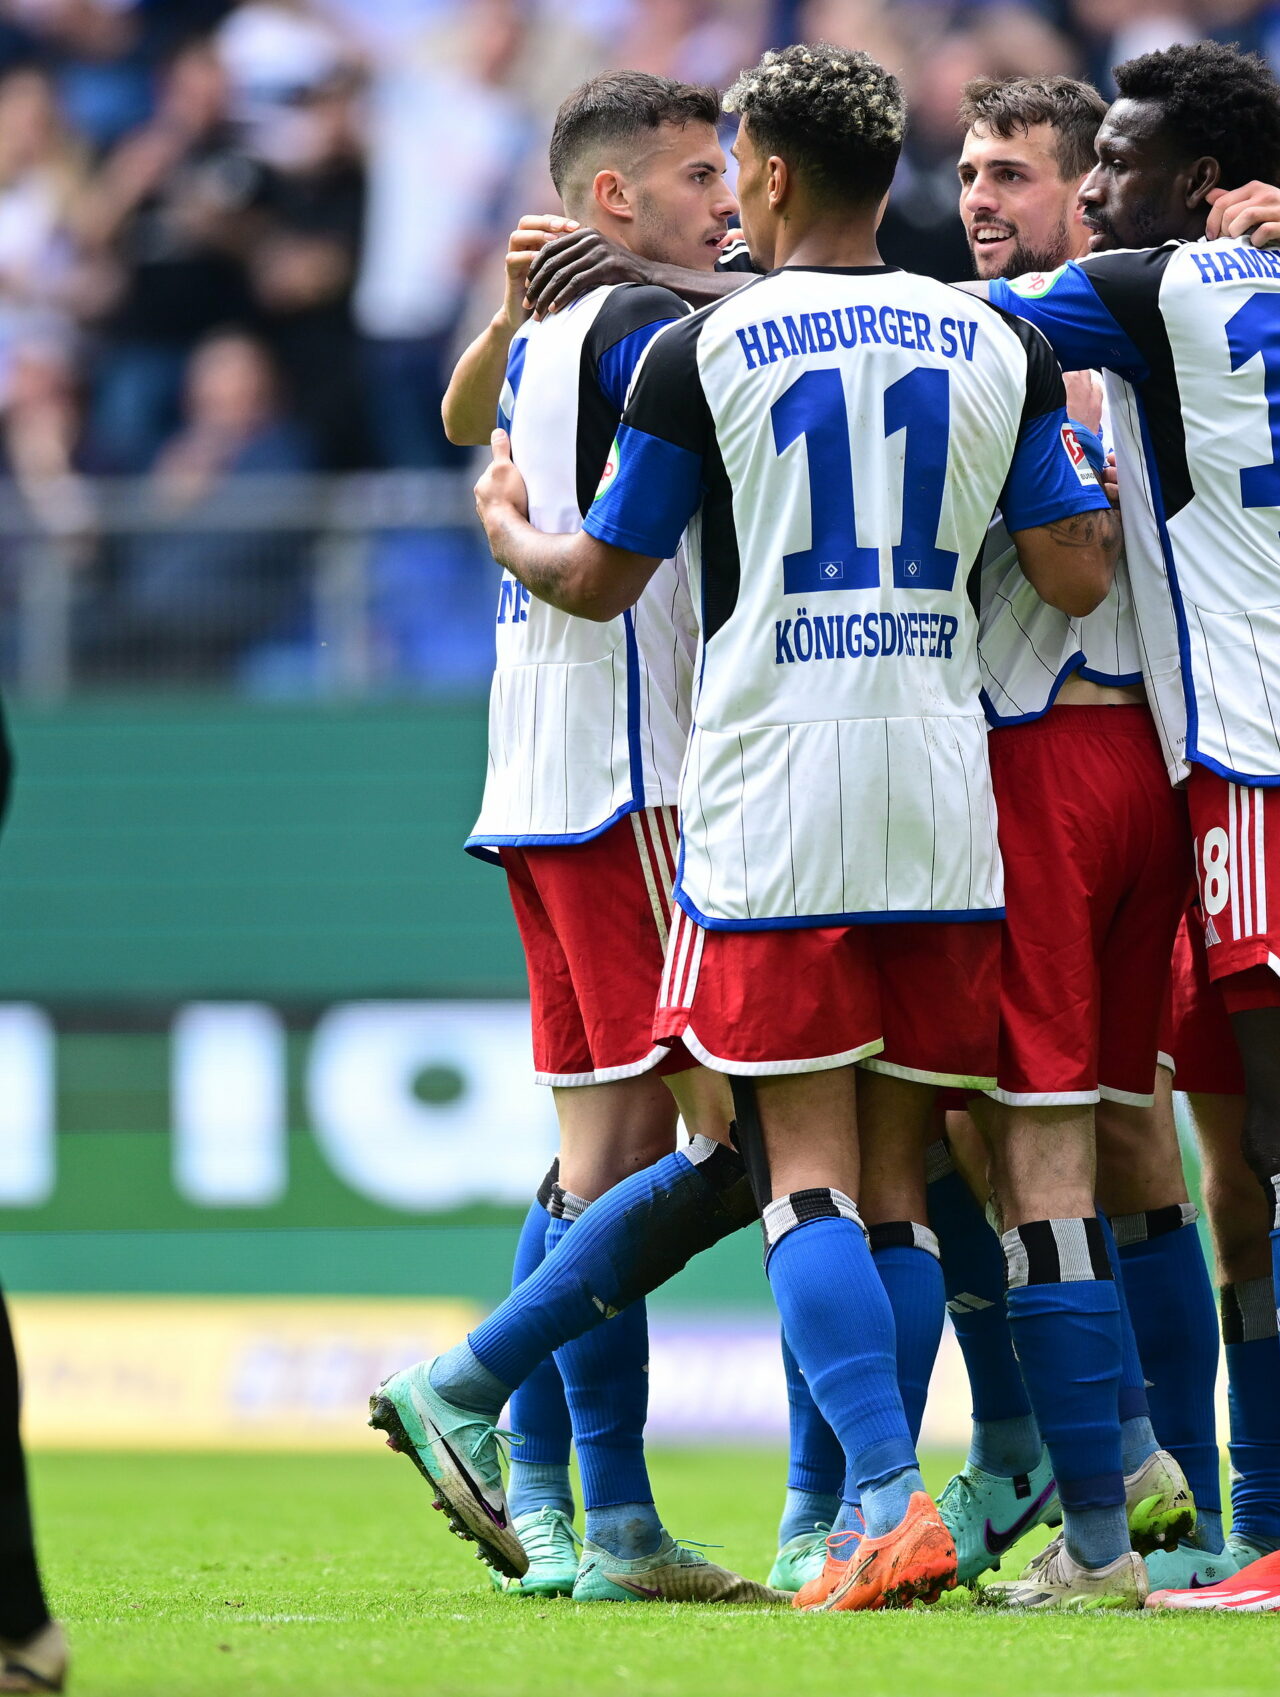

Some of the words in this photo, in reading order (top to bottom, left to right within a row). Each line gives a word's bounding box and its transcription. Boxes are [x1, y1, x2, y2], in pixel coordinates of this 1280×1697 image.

[735, 304, 935, 370] HAMBURGER
[940, 316, 979, 362] SV
[770, 366, 960, 594] 11
[775, 607, 958, 665] KÖNIGSDRFFER
[1193, 826, 1230, 921] 8
